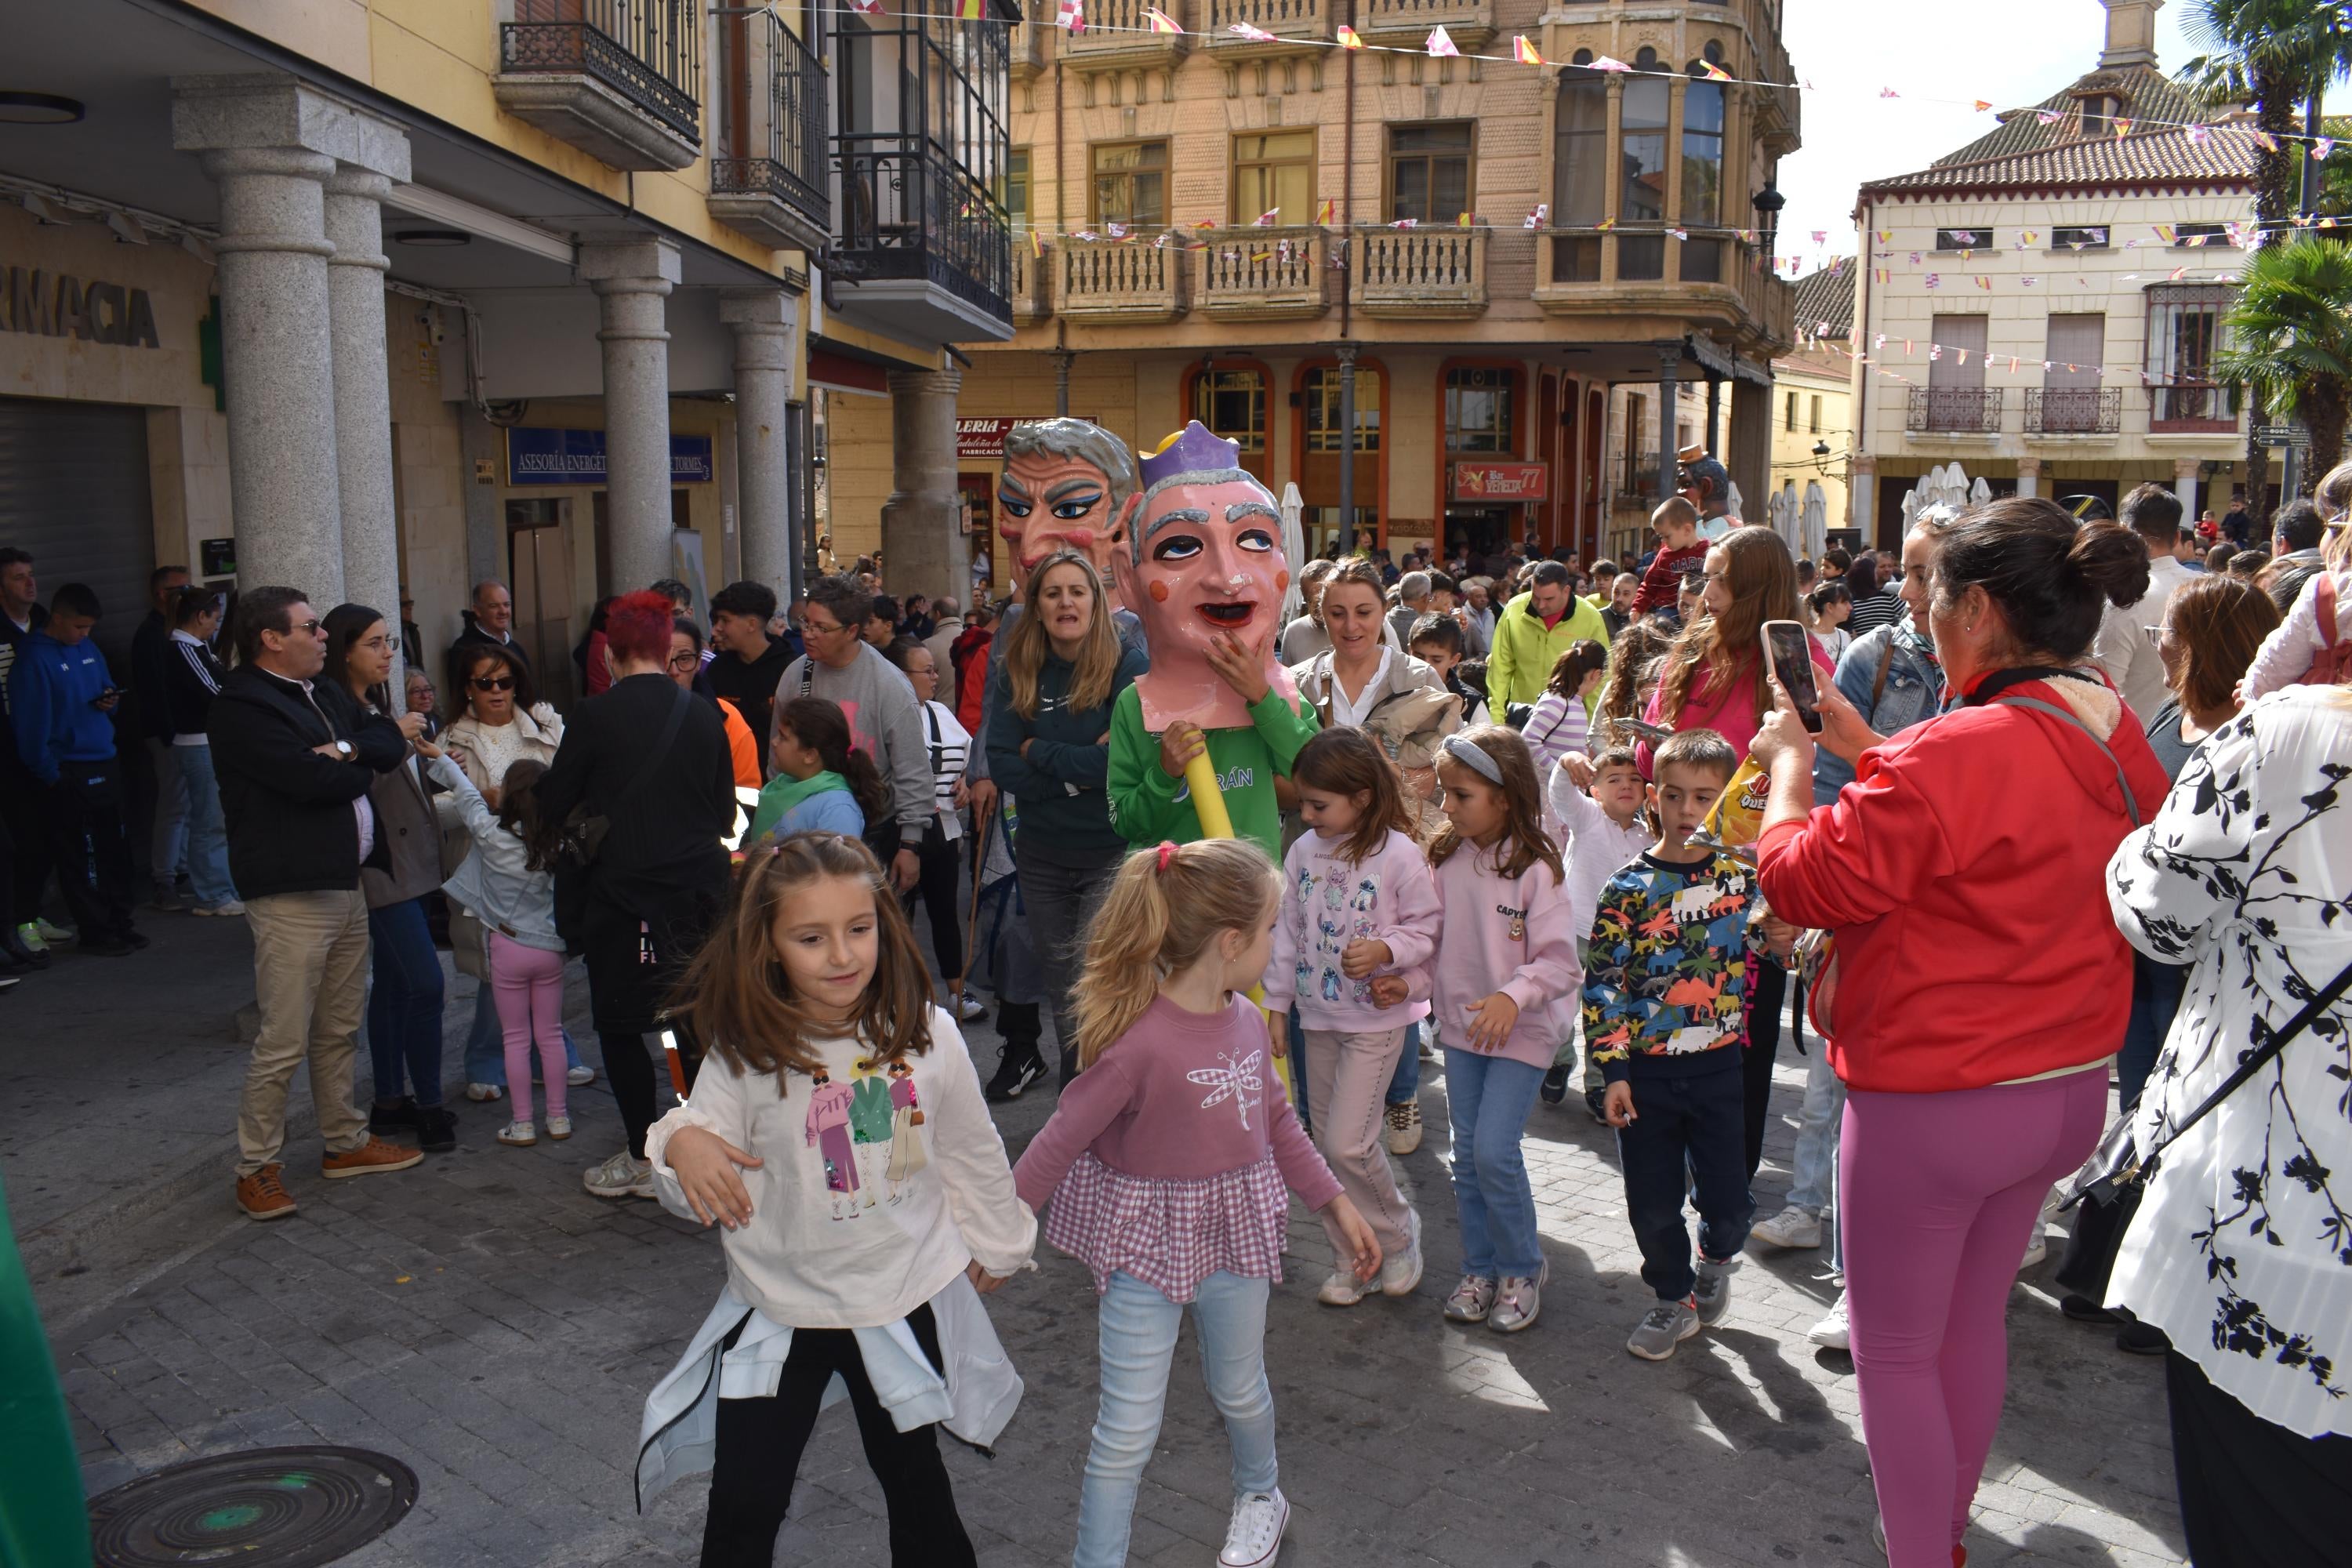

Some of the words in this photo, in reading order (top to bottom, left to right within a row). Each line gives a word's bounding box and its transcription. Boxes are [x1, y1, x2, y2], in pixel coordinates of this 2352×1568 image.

[518, 450, 565, 471] ASESORÍA
[674, 456, 702, 471] TORMES
[1519, 469, 1541, 489] 77
